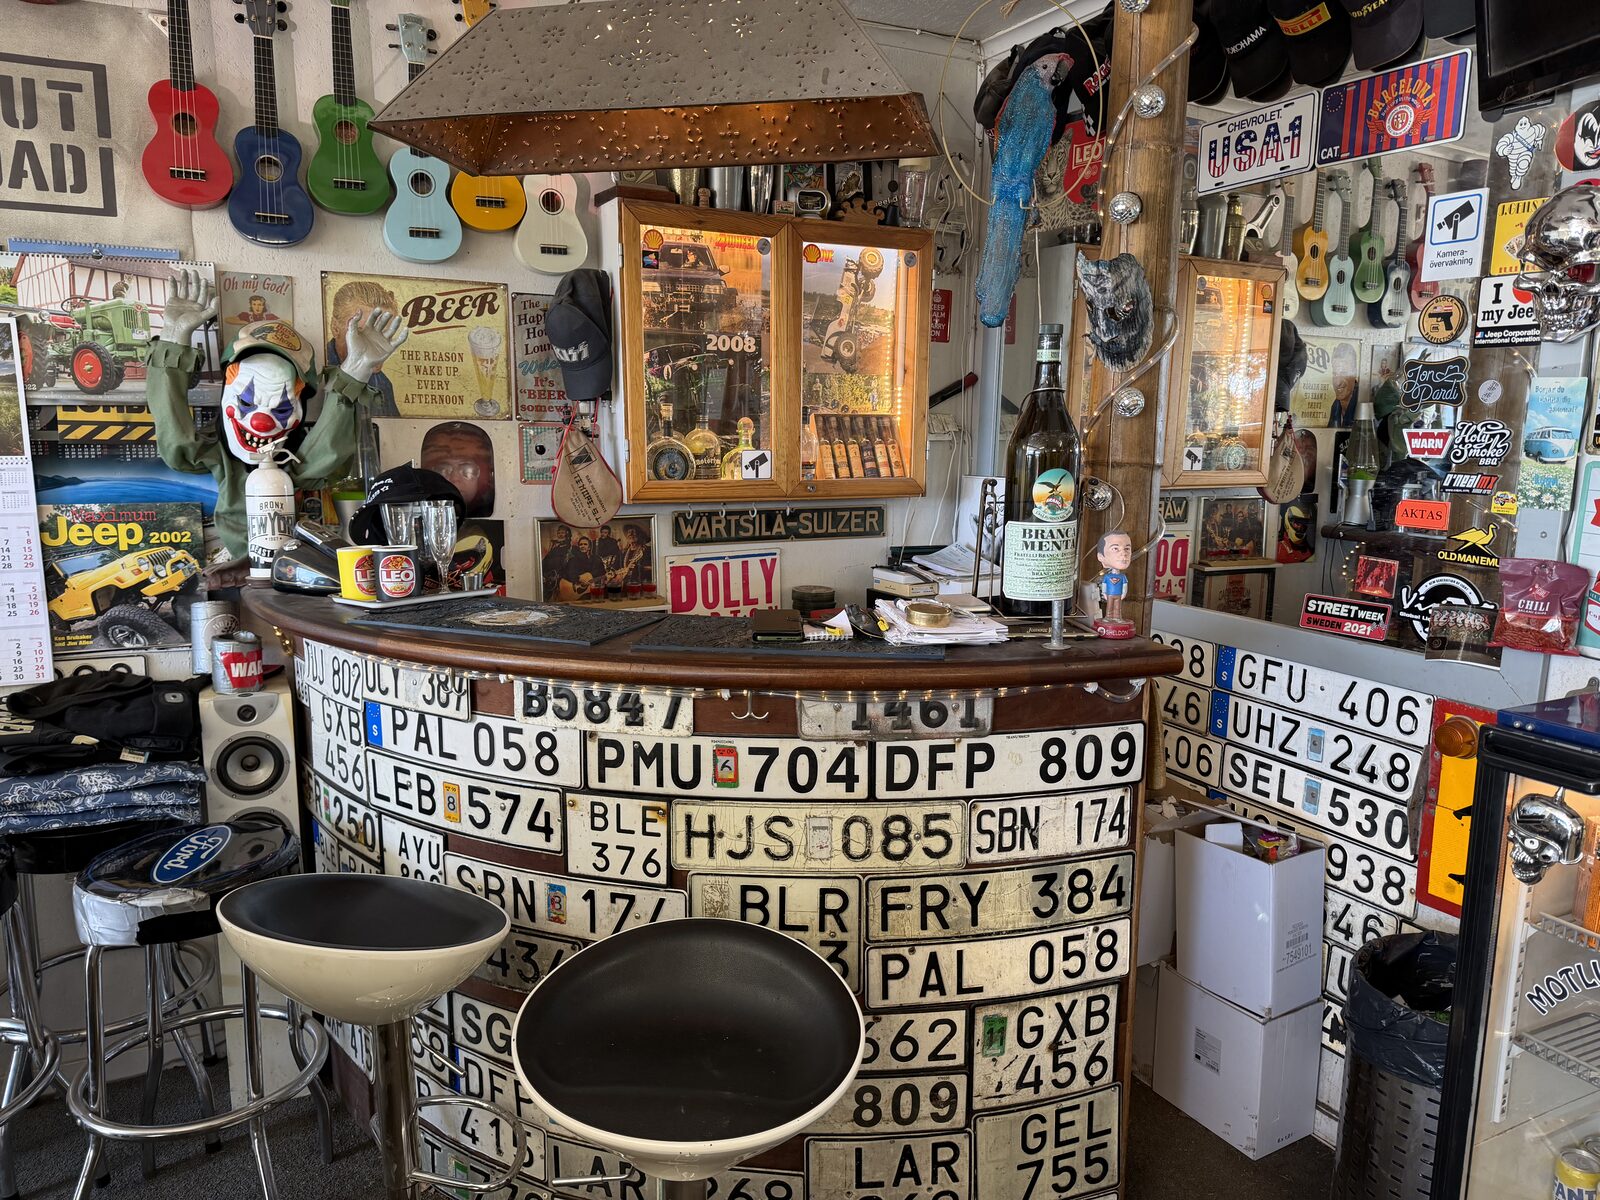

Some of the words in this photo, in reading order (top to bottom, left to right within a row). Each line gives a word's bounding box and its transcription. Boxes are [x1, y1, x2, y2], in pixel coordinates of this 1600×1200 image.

[1367, 77, 1436, 120] BARCELONA
[1227, 108, 1283, 133] CHEVROLET
[1075, 143, 1103, 164] LEO
[1207, 115, 1303, 178] USA-1
[0, 140, 88, 194] AD
[1429, 255, 1474, 270] övervakning
[1436, 248, 1468, 260] Kamera-
[223, 276, 239, 291] Oh
[242, 280, 260, 292] my
[262, 277, 290, 296] God!
[1491, 283, 1504, 305] I
[401, 291, 500, 329] BEER
[520, 299, 541, 311] The
[1481, 307, 1505, 325] my
[1507, 304, 1537, 322] Jee
[551, 340, 590, 363] KISS
[705, 334, 757, 354] 2008
[1474, 337, 1511, 346] International
[1511, 335, 1541, 344] Operation
[1484, 329, 1503, 339] Jeep
[1502, 328, 1541, 338] Corporatio
[400, 350, 421, 362] THE
[424, 350, 465, 363] REASON
[407, 364, 413, 375] I
[414, 365, 442, 377] WAKE
[444, 366, 459, 377] UP
[403, 393, 465, 406] AFTERNOON
[416, 379, 451, 392] EVERY
[533, 377, 555, 388] It's
[1411, 381, 1459, 412] Pardi
[1411, 437, 1444, 449] WARN
[1478, 457, 1498, 466] BBQ
[71, 508, 157, 523] Maximum
[259, 500, 285, 511] BRONX
[1401, 508, 1443, 521] AKTAS
[41, 515, 144, 551] Jeep
[149, 531, 192, 544] 2002
[677, 510, 880, 542] WÄRTSILÄ-SULZER
[1021, 527, 1076, 540] BRANCA
[24, 561, 35, 569] 29
[356, 569, 376, 582] LE
[381, 569, 415, 582] LEO
[1437, 550, 1457, 561] OLD
[1457, 552, 1481, 565] MAN
[671, 557, 778, 614] DOLLY
[1307, 599, 1358, 618] STREET
[1358, 609, 1385, 622] WEEK
[1518, 599, 1551, 612] CHILI
[1105, 629, 1129, 637] SHELDON
[1306, 616, 1342, 630] SWEDEN
[1343, 622, 1373, 636] 2021
[35, 671, 45, 679] 31
[332, 655, 362, 704] 802
[1221, 669, 1228, 682] S
[1155, 680, 1203, 726] 46
[1237, 653, 1309, 704] GFU
[1337, 680, 1421, 736] 406
[321, 695, 363, 748] GXB
[372, 724, 379, 737] S
[1216, 717, 1224, 730] S
[391, 708, 457, 761] PAL
[473, 720, 560, 777] 058
[885, 741, 996, 792] DFP
[1038, 730, 1137, 784] 809
[1231, 701, 1302, 758] UHZ
[1329, 733, 1412, 795] 248
[325, 737, 365, 793] 456
[596, 737, 702, 790] PMU
[747, 745, 860, 794] 704
[370, 757, 437, 817] LEB
[467, 784, 555, 843] 574
[1222, 752, 1296, 808] SEL
[1326, 777, 1409, 849] 530
[333, 794, 377, 853] 250
[590, 800, 662, 838] BLE
[684, 812, 794, 862] HJS
[841, 811, 953, 862] 085
[975, 805, 1041, 855] SBN
[1074, 795, 1127, 846] 174
[162, 831, 225, 872] Ford
[398, 831, 441, 871] AYU
[591, 841, 662, 879] 376
[1325, 842, 1408, 907] 938
[455, 864, 537, 924] SBN
[740, 884, 850, 933] BLR
[880, 880, 990, 932] FRY
[1031, 863, 1126, 919] 384
[881, 949, 985, 1001] PAL
[1028, 928, 1119, 985] 058
[1525, 959, 1600, 1017] MOTL
[460, 1002, 514, 1056] SG
[861, 1017, 958, 1064] 662
[1016, 994, 1112, 1050] GXB
[1014, 1039, 1109, 1096] 456
[464, 1056, 535, 1119] DFP
[852, 1080, 959, 1129] 809
[1020, 1100, 1113, 1156] GEL
[854, 1141, 961, 1190] LAR
[1016, 1141, 1110, 1200] 755
